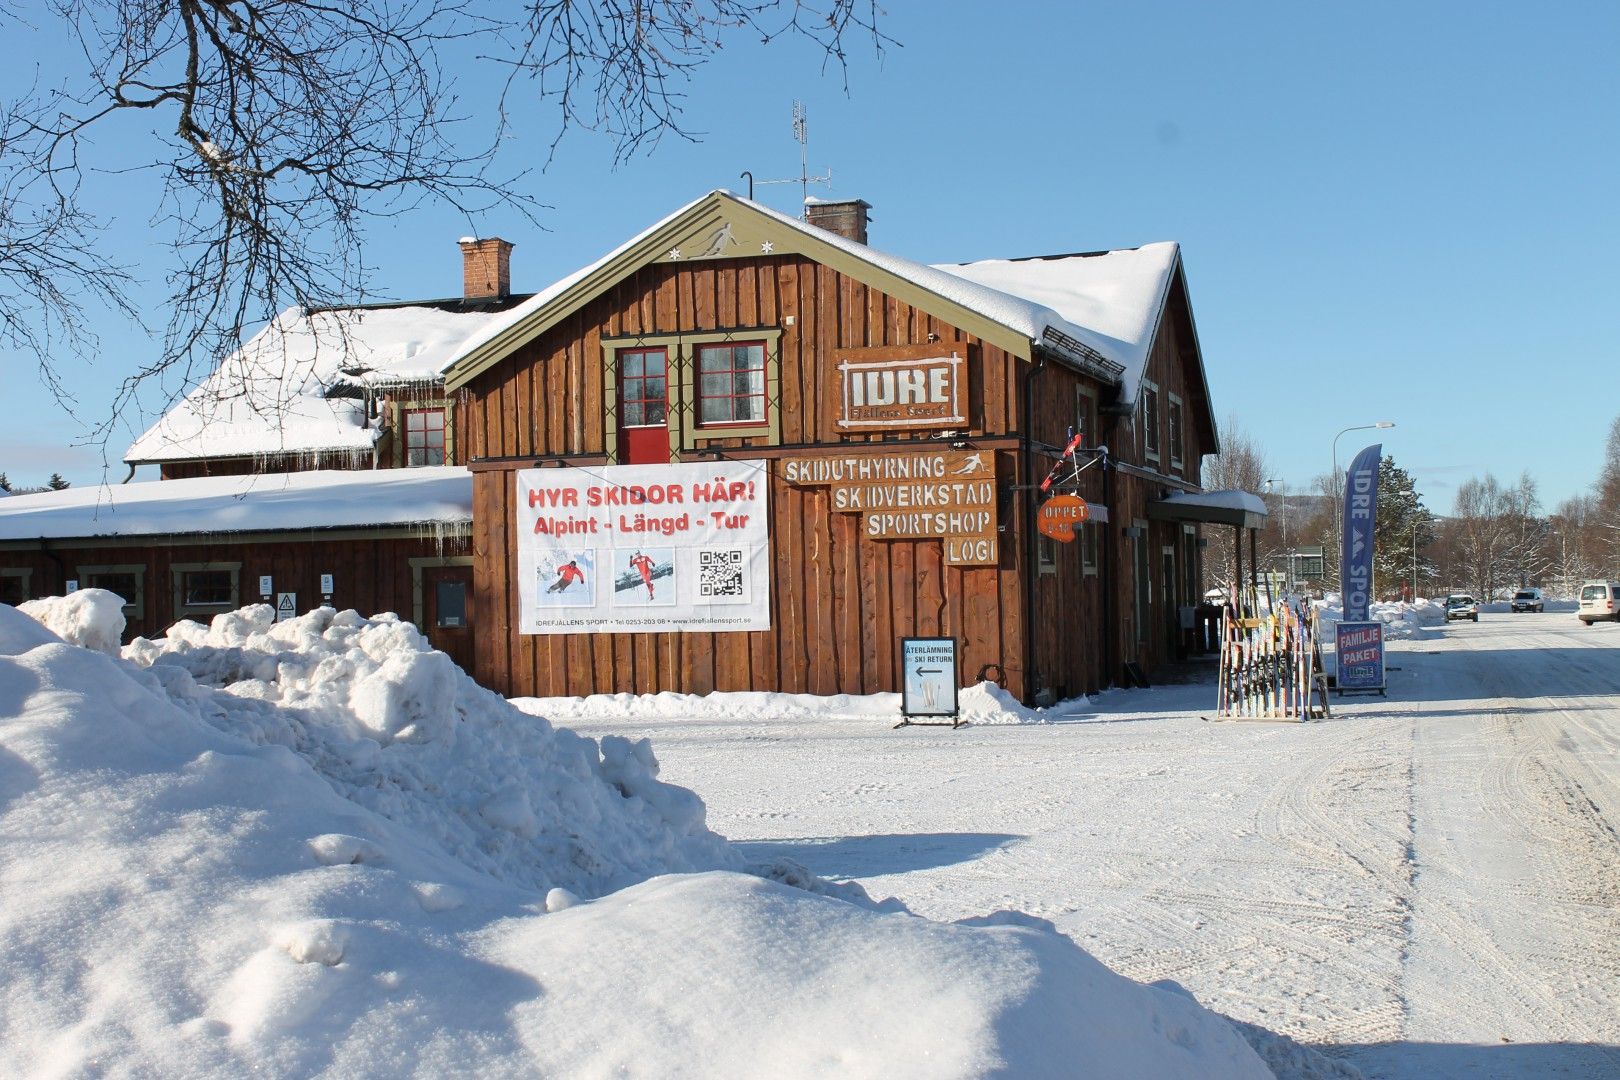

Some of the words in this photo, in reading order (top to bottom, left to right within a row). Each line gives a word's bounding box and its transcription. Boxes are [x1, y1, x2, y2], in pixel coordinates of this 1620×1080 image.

[852, 367, 949, 406] IDRE
[785, 456, 945, 482] SKIDUTHYRNING
[528, 487, 578, 508] HYR
[587, 484, 683, 506] SKIDOR
[692, 476, 756, 503] HÄR!
[835, 483, 992, 508] SKIDVERKSTAD
[1351, 469, 1372, 519] IDRE
[534, 515, 597, 537] Alpint
[620, 513, 689, 535] Längd
[711, 511, 749, 530] Tur
[868, 512, 990, 535] SPORTSHOP
[949, 540, 994, 562] LOGI
[906, 646, 952, 654] ÅTERLÄMNING
[1340, 628, 1379, 648] FAMILJE
[1343, 647, 1376, 665] PAKET
